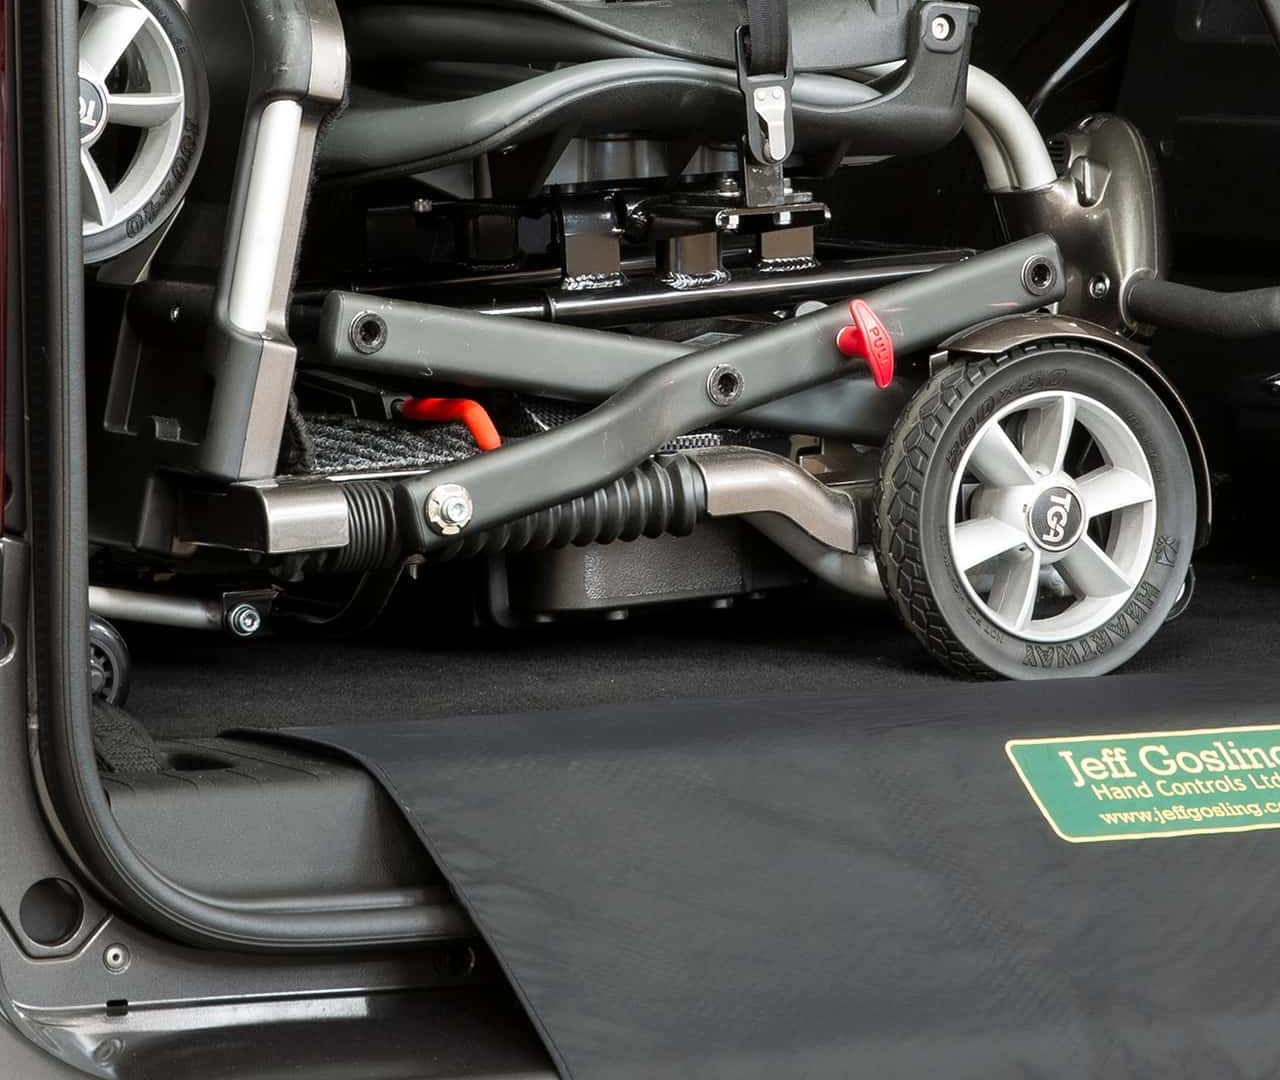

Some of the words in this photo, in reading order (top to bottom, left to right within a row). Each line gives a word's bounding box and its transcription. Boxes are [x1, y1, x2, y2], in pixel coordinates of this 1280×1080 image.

[1042, 494, 1072, 543] TGA
[1022, 580, 1161, 668] HEARTWAY
[1058, 748, 1137, 787] Jeff
[1091, 778, 1153, 801] Hand
[1160, 775, 1246, 798] Controls
